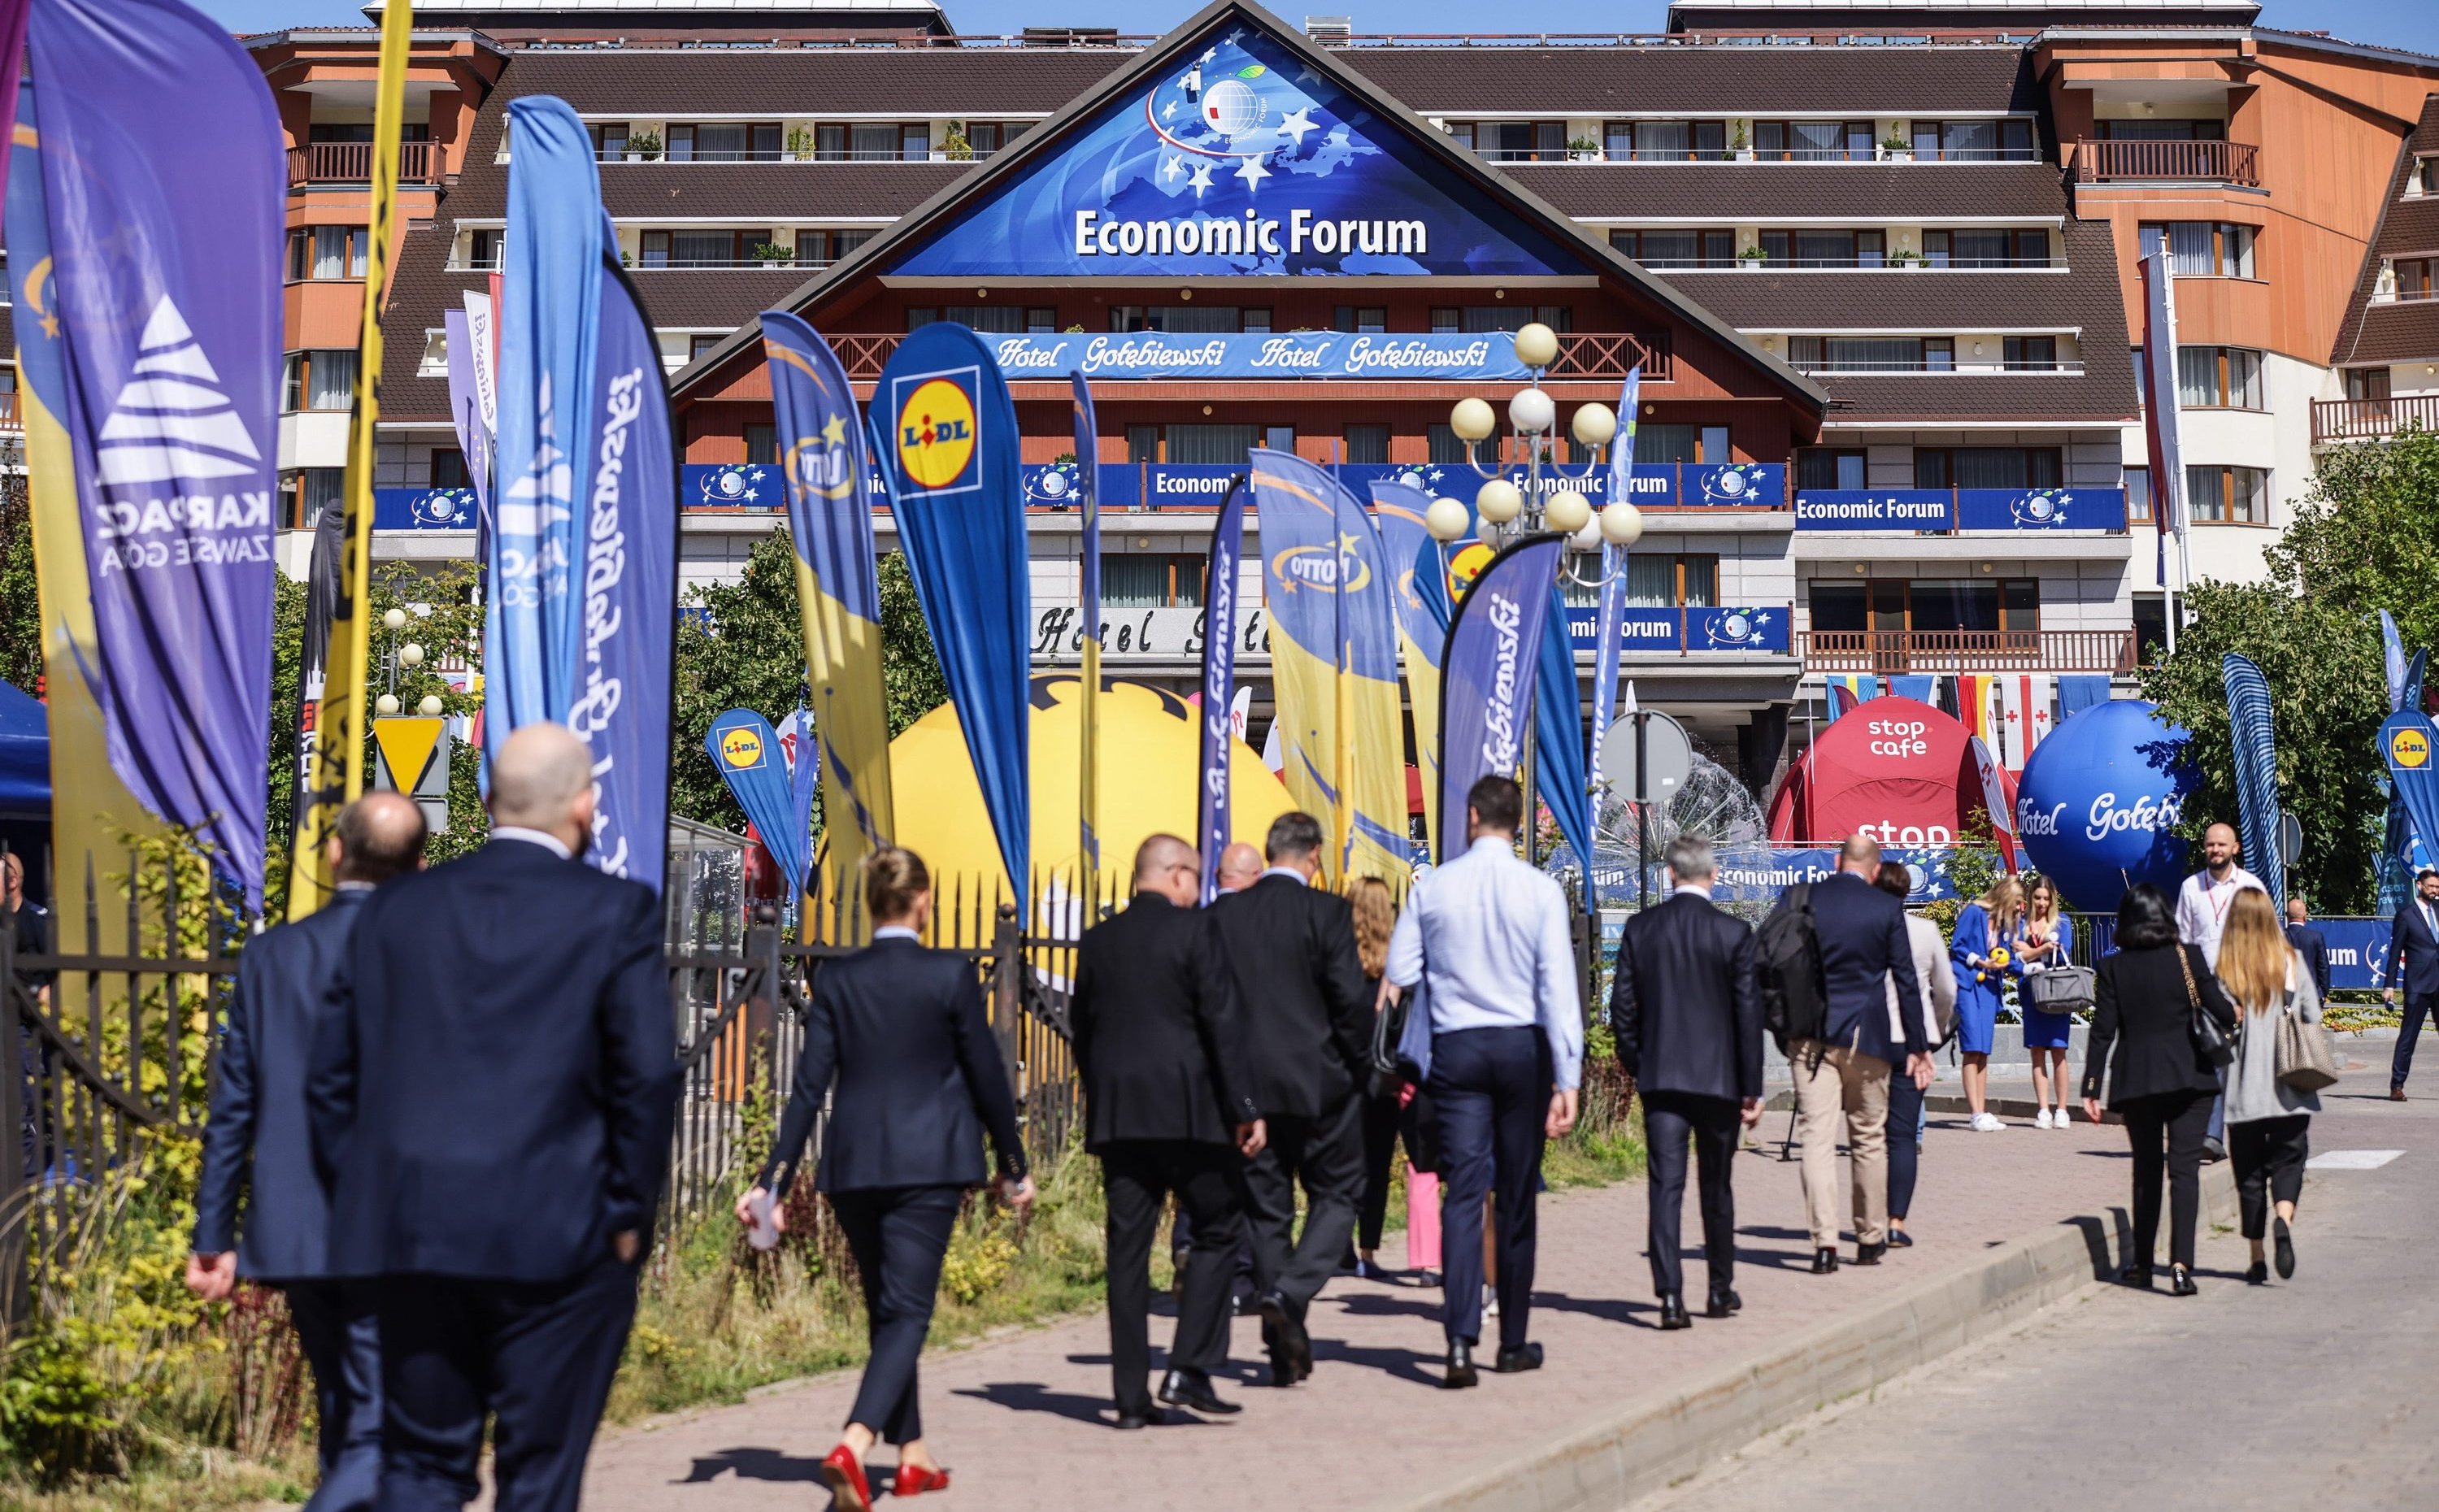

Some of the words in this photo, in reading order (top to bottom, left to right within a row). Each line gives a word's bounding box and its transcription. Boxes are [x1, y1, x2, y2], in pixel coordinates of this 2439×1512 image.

[1224, 123, 1261, 144] ECONOMIC
[1259, 98, 1267, 122] FORUM
[1075, 208, 1280, 254] Economic
[1290, 208, 1428, 254] Forum
[997, 338, 1067, 367] Hotel
[1082, 336, 1226, 372] Gołębiewski
[1250, 337, 1330, 367] Hotel
[1345, 336, 1489, 372] Gołębiewski
[1797, 498, 1882, 519] Economic
[1887, 498, 1944, 518] Forum
[1620, 620, 1672, 637] orum
[1870, 738, 1927, 758] cafe
